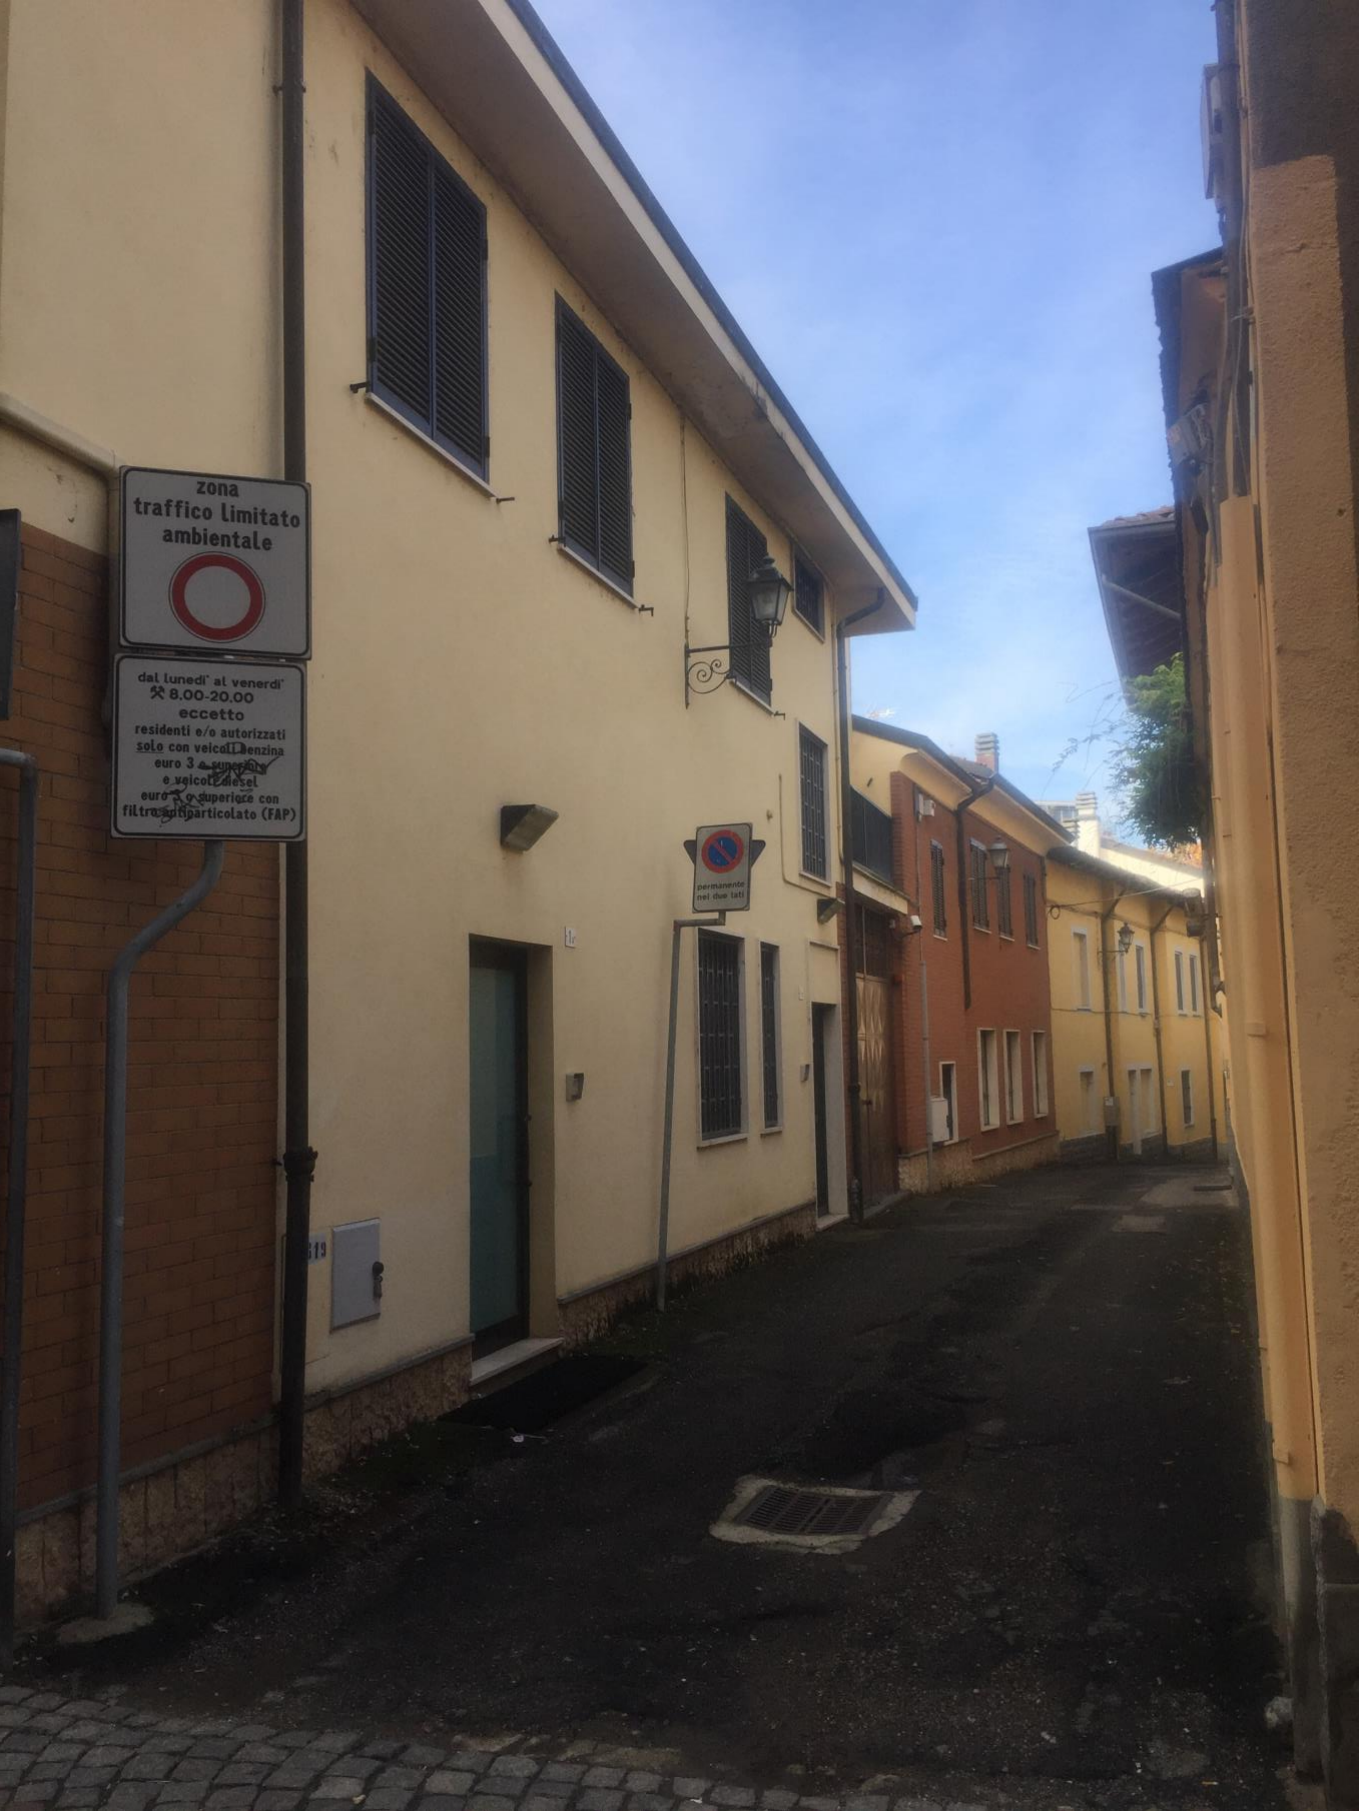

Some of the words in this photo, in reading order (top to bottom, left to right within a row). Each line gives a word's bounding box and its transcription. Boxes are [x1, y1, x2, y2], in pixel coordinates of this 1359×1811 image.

[196, 481, 239, 497] zona
[133, 497, 213, 520] traffico
[221, 502, 300, 528] limitato
[162, 527, 273, 551] ambientale
[138, 672, 159, 683] dal
[214, 676, 227, 687] al
[169, 688, 254, 703] 8.00-20.00
[179, 708, 245, 721] eccetto
[135, 724, 190, 737] residenti
[195, 725, 216, 738] e/o
[220, 728, 286, 740] autorizzati
[136, 739, 164, 752] solo
[168, 744, 190, 753] con
[194, 742, 236, 755] veicoli
[240, 743, 285, 757] enzina
[154, 759, 182, 769] euro
[186, 757, 195, 769] 3
[163, 776, 170, 785] e
[221, 775, 259, 788] diesel
[141, 790, 168, 801] euro
[186, 793, 194, 802] o
[198, 791, 254, 805] superiore
[122, 805, 158, 818] filtro
[261, 807, 297, 822] (FAP)
[697, 881, 745, 891] permanente
